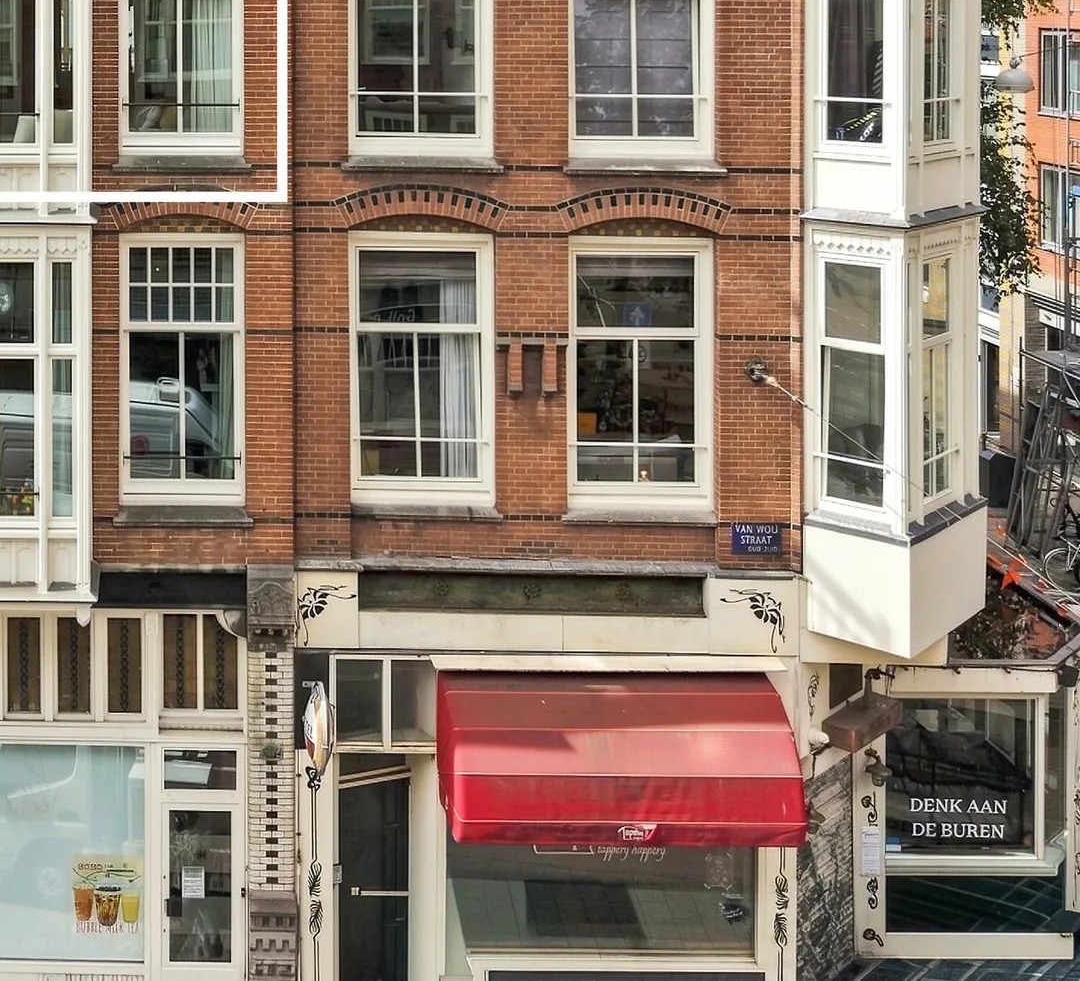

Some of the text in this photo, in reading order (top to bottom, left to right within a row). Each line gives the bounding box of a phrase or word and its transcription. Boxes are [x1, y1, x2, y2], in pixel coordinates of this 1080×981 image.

[735, 524, 778, 534] VAN WOU
[740, 535, 772, 544] STRAAT
[910, 798, 1008, 814] DENK AAN
[911, 822, 1005, 838] DE BUREN
